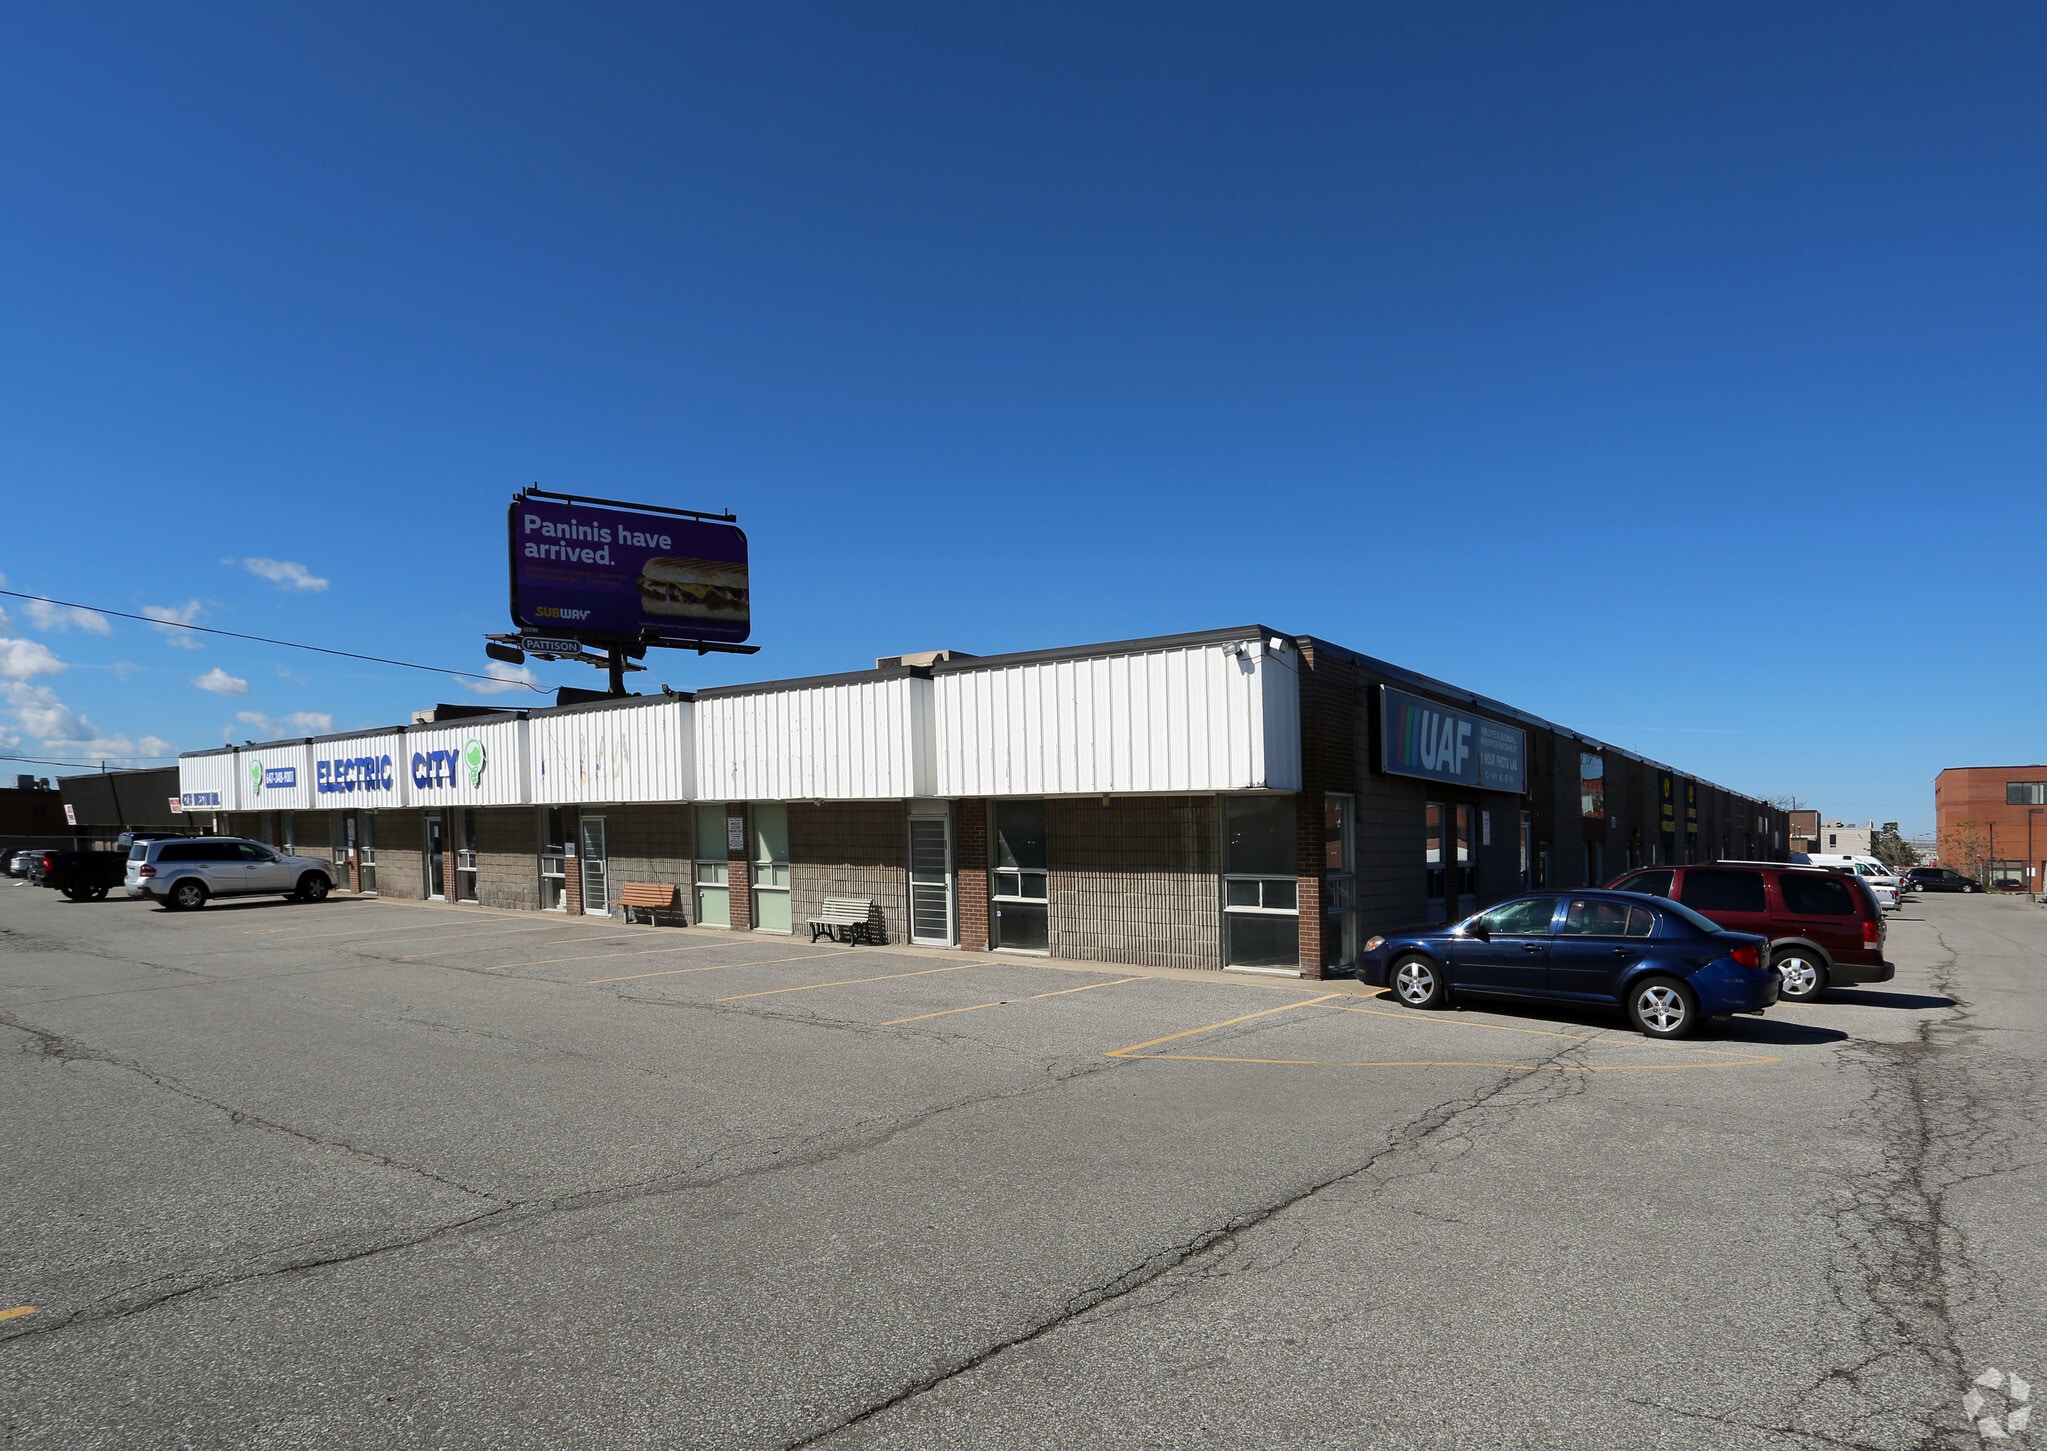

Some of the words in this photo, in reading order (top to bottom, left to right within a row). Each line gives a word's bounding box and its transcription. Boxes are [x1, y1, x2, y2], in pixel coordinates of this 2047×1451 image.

[524, 514, 612, 543] Paninis
[618, 525, 672, 550] have
[524, 541, 615, 566] arrived.
[534, 606, 591, 620] SUBWAY
[526, 640, 577, 651] PATTISON
[1420, 710, 1472, 774] UAF
[1481, 726, 1517, 745] PROFESSIONAL
[317, 754, 393, 794] ELECTRIC
[412, 749, 460, 790] CITY
